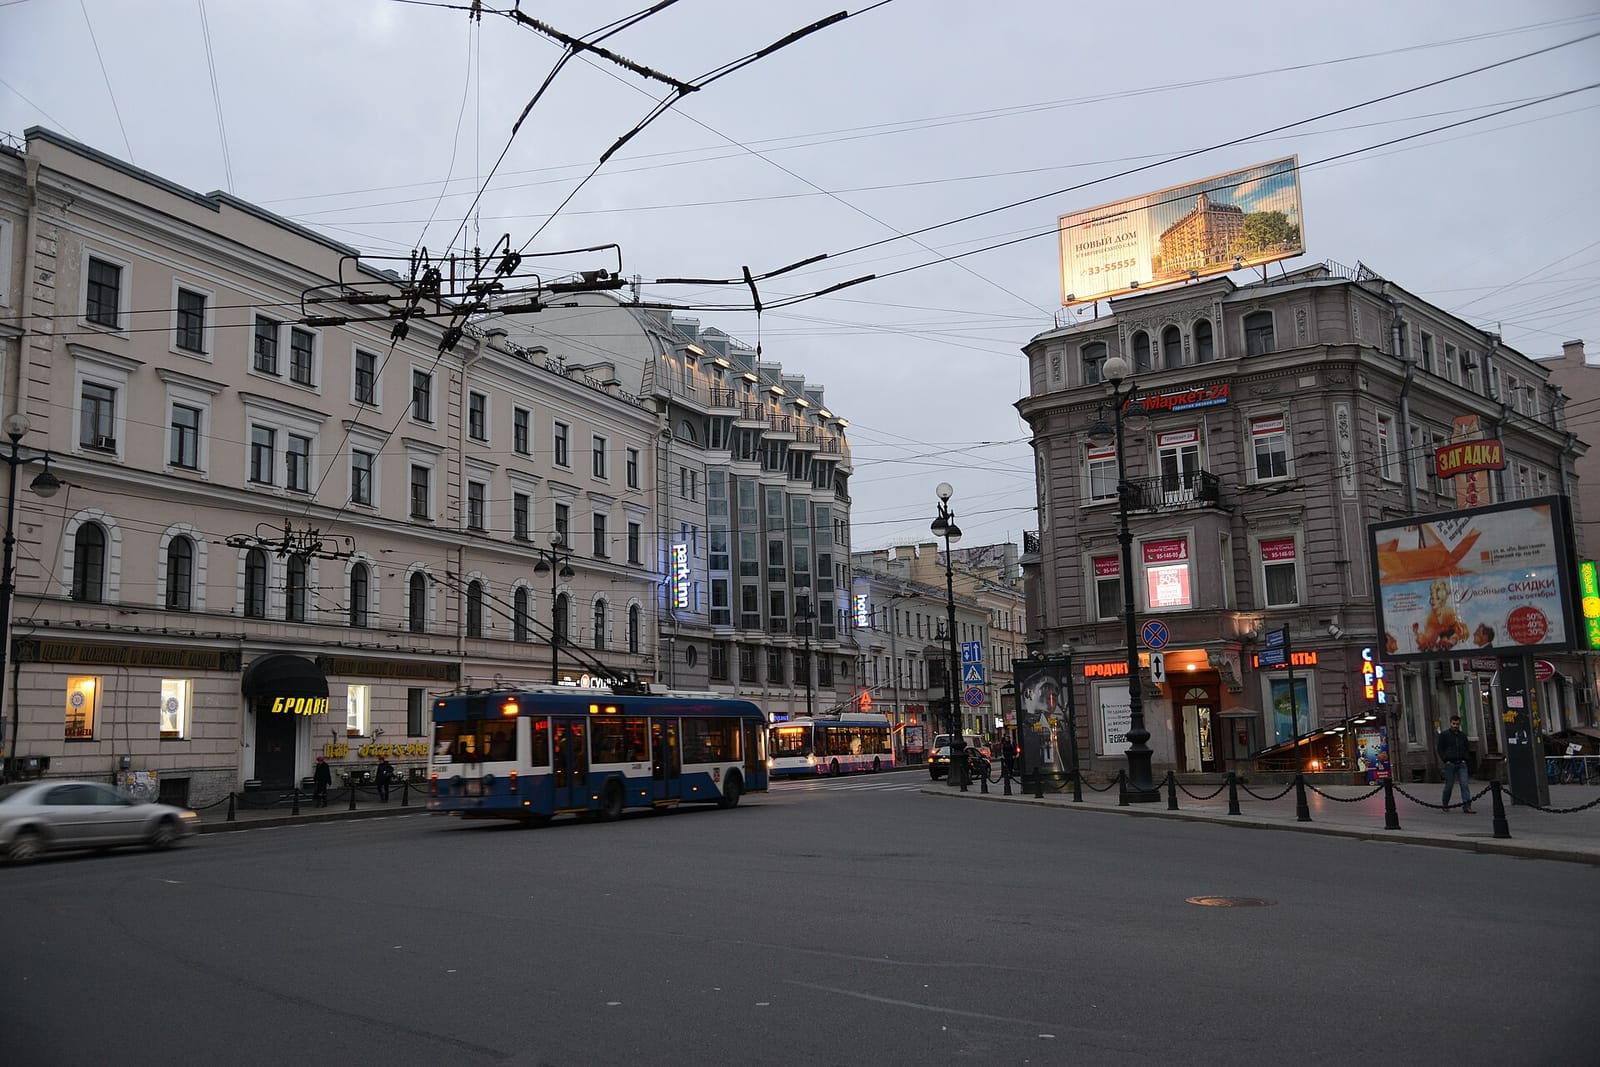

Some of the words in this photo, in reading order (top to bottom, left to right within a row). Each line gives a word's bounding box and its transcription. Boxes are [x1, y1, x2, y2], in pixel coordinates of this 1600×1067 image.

[1075, 235, 1113, 252] НОВЫЙ
[1114, 231, 1137, 244] ДОМ
[1088, 257, 1136, 276] 33-55555
[1439, 445, 1500, 471] ЗАГАДКА
[673, 543, 691, 580] park
[678, 582, 691, 608] inn
[1507, 578, 1555, 593] СКИДКИ
[857, 594, 869, 627] hotel
[1084, 661, 1129, 677] ПРОДУКТ
[1361, 647, 1375, 699] CAFE
[1375, 665, 1387, 704] BAR
[406, 743, 429, 757] ФРЕ
